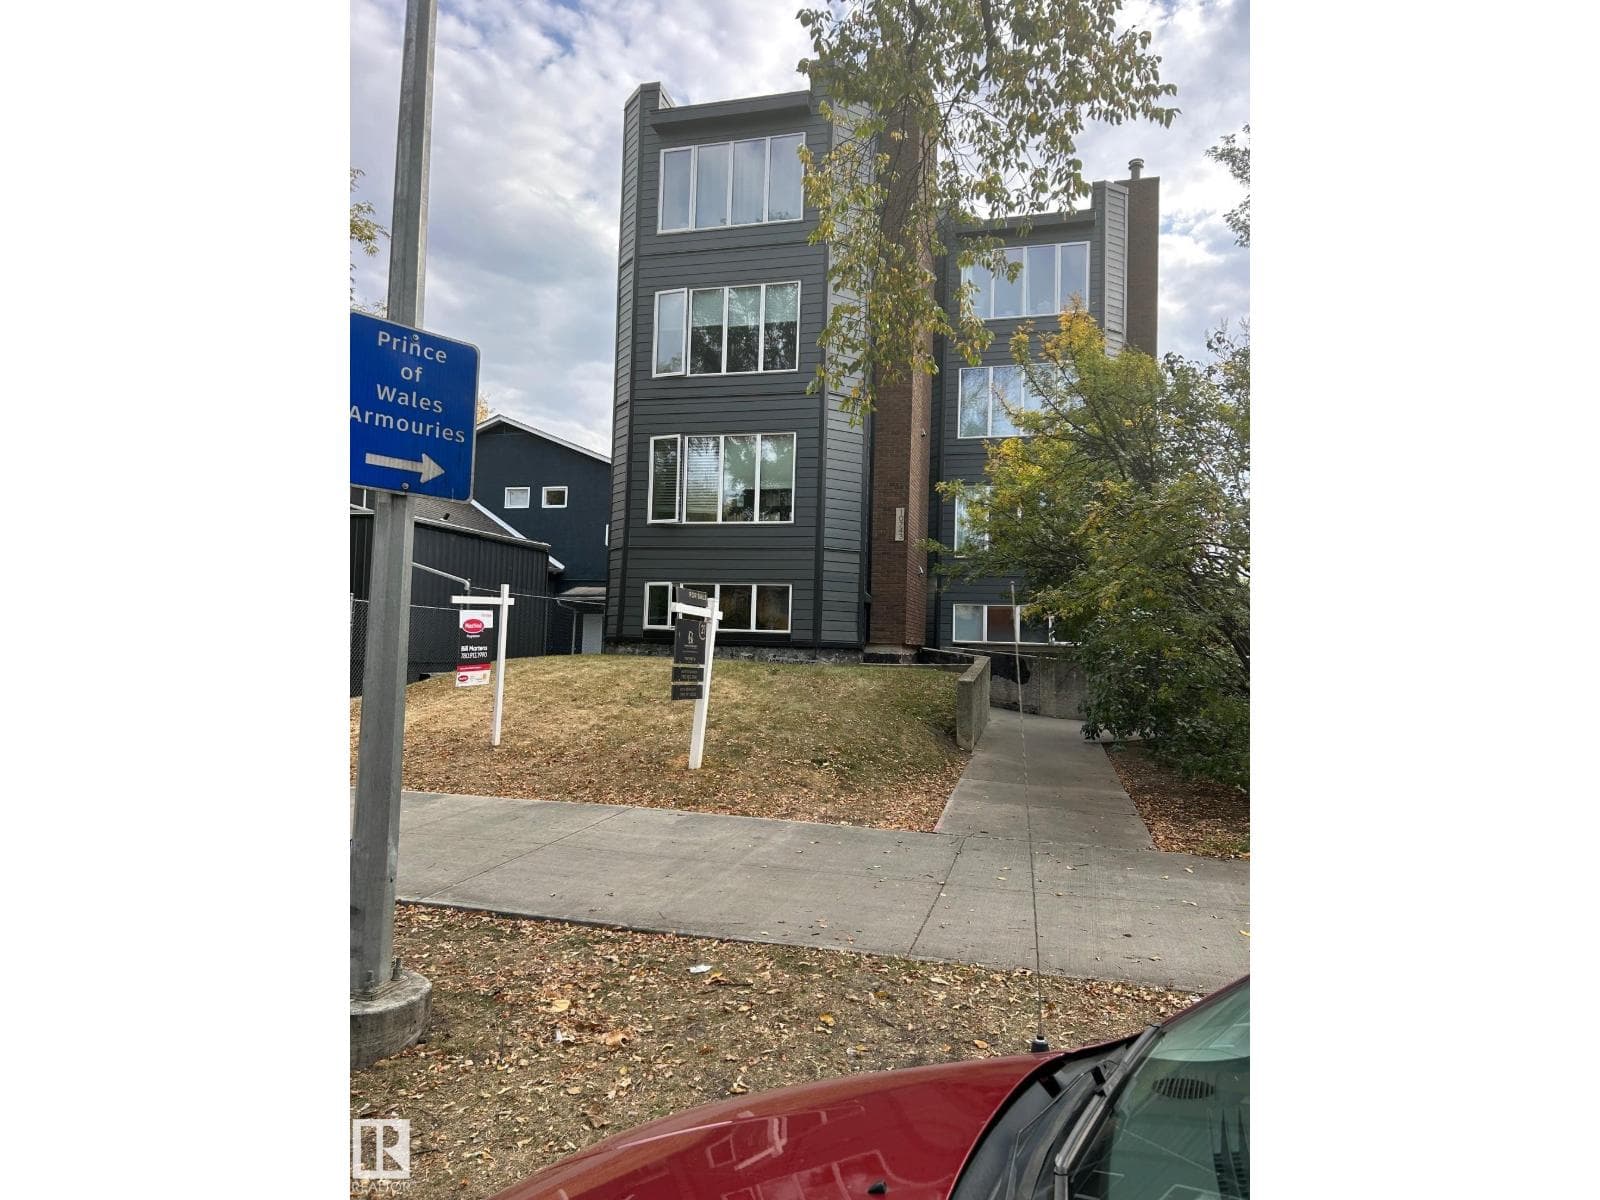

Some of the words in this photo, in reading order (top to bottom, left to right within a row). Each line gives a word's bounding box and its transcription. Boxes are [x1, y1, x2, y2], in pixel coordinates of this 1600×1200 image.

[377, 330, 447, 364] Prince
[400, 366, 423, 382] of
[376, 384, 443, 413] Wales
[350, 405, 465, 443] Armouries
[688, 591, 697, 600] FOR
